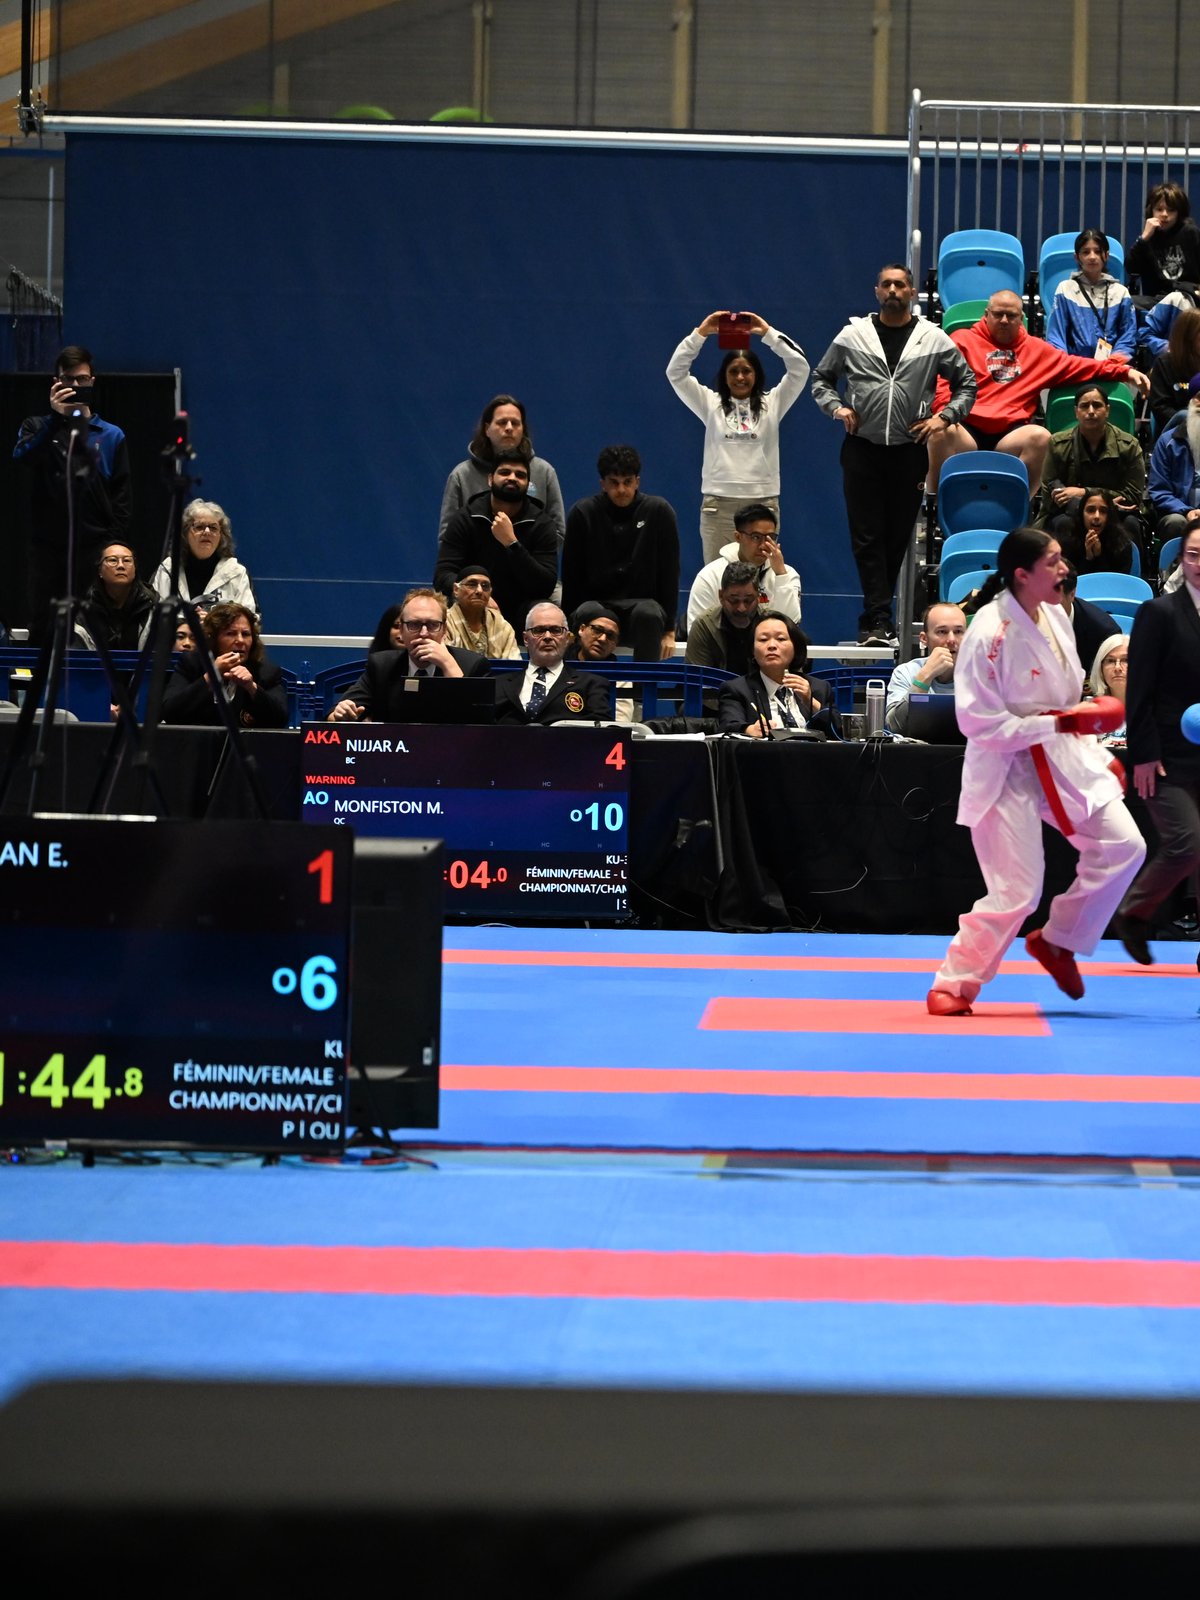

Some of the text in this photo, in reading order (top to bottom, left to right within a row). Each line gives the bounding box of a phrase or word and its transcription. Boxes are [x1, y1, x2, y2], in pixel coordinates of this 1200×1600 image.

[304, 730, 341, 744] AKA
[346, 739, 409, 753] NIJJAR A.
[345, 757, 356, 765] BC
[605, 742, 626, 771] 4
[305, 775, 356, 785] WARNING
[303, 791, 329, 805] AO
[334, 800, 444, 815] MONFISTON M.
[334, 817, 346, 825] QC
[48, 842, 68, 868] E.
[308, 849, 334, 904] 1
[526, 865, 611, 880] FÉMININ/FEMALE
[173, 1058, 335, 1087] FÉMININ/FEMALE
[0, 1052, 144, 1110] :44.8
[282, 1120, 296, 1139] P
